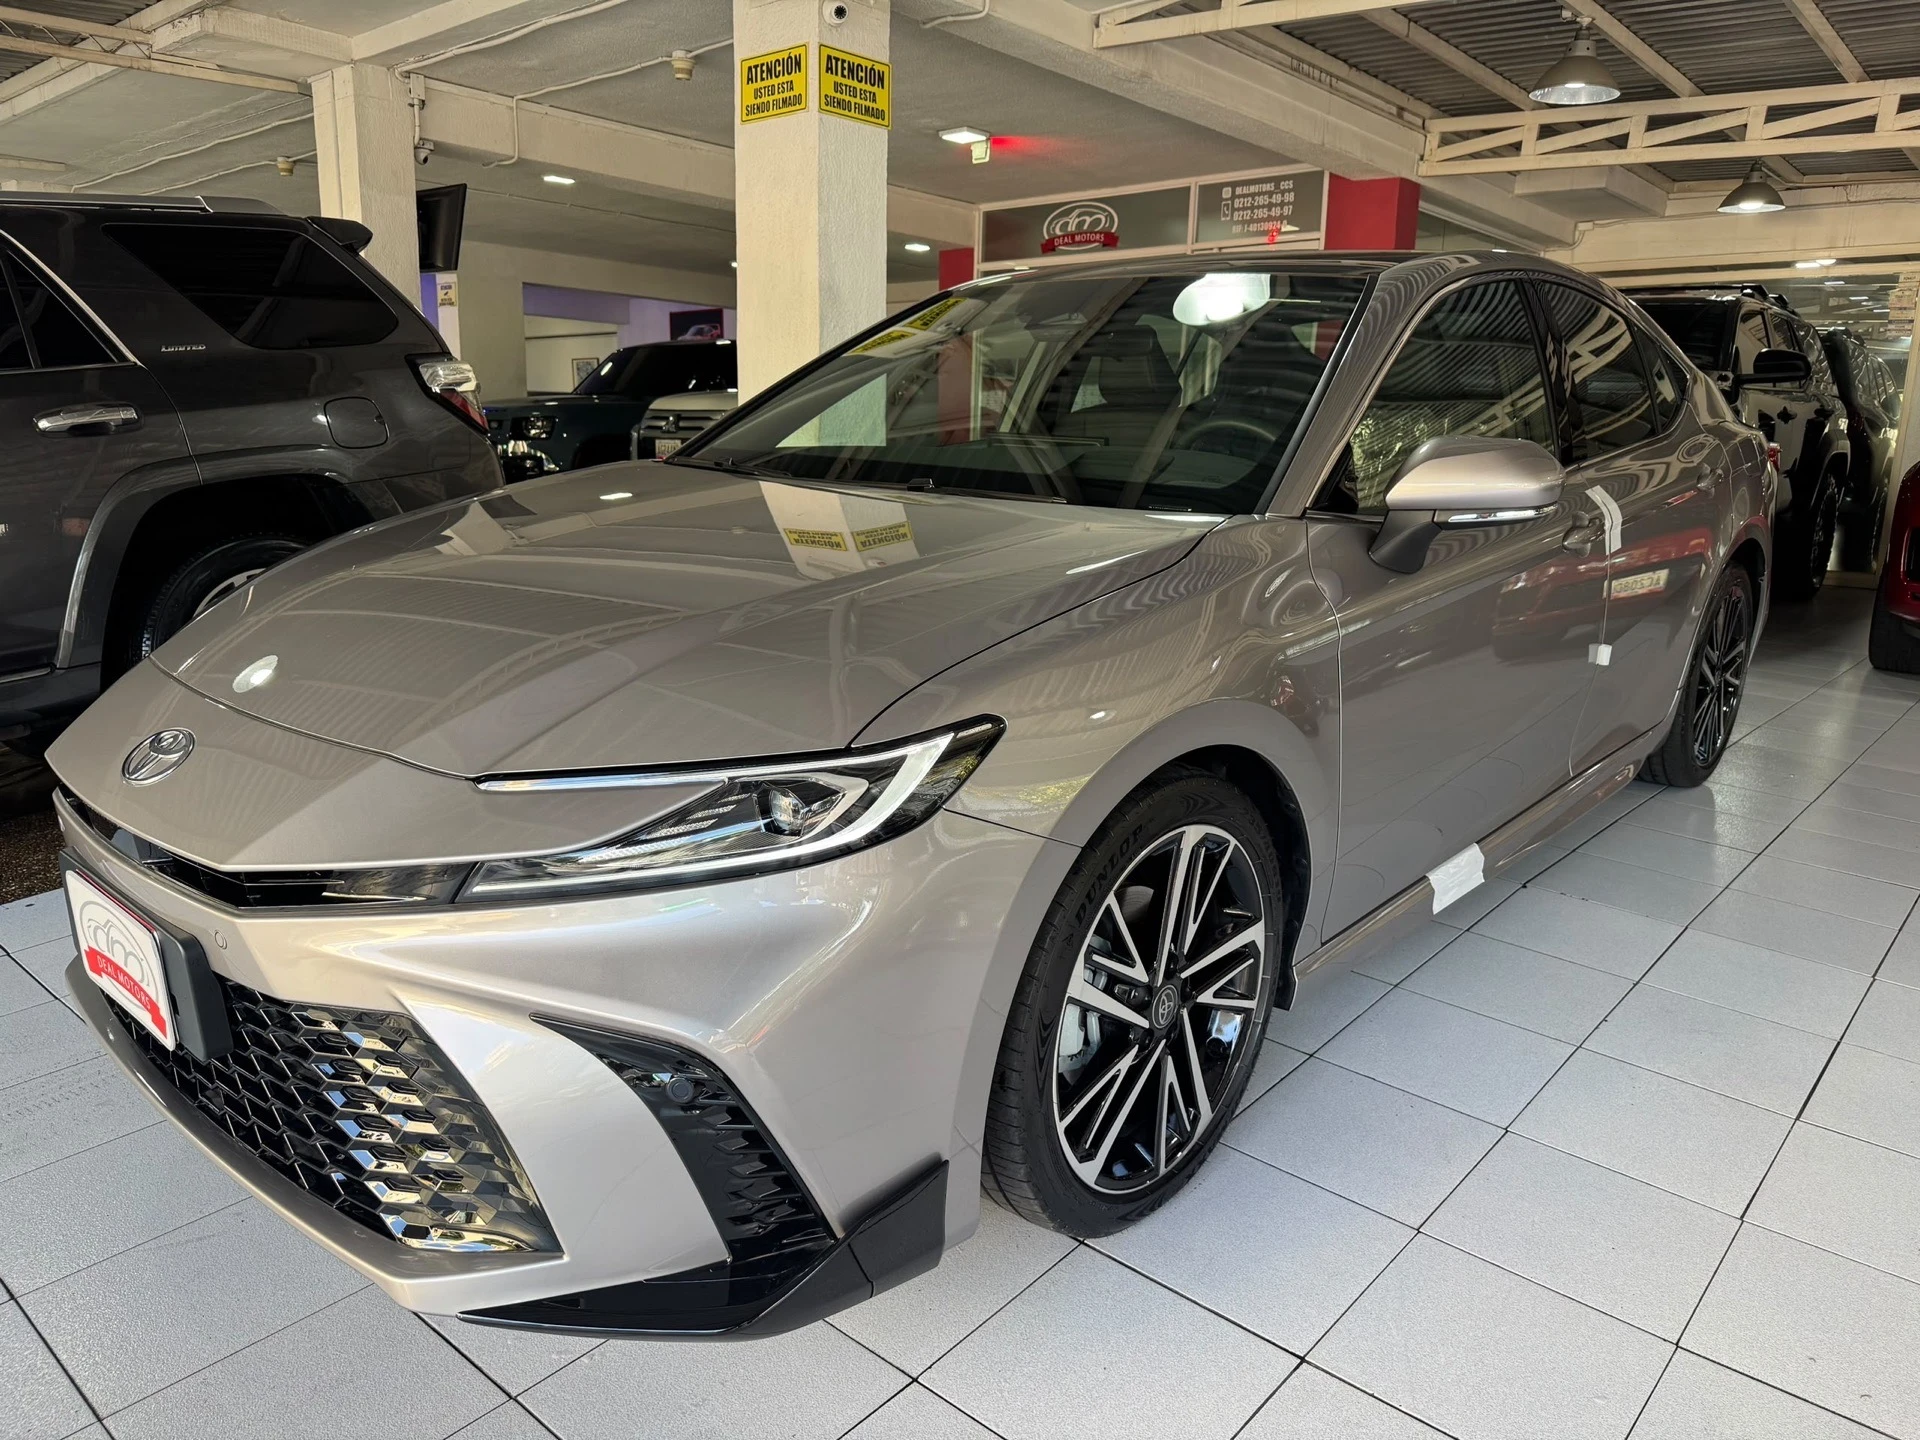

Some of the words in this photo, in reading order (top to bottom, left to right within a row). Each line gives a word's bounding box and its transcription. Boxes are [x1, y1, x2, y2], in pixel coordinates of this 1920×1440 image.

[746, 52, 801, 85] ATENCIÓN
[825, 53, 885, 90] ATENCIÓN
[753, 83, 775, 100] USTED
[777, 80, 794, 93] ESTA
[833, 81, 857, 98] USTED
[860, 88, 877, 104] ESTA
[745, 100, 770, 117] SIENDO
[772, 93, 803, 111] FILMADO
[824, 94, 852, 113] SIENDO
[853, 103, 886, 121] FILMADO
[1054, 236, 1073, 246] DEAL
[1074, 233, 1105, 242] MOTORS
[1075, 824, 1143, 925] DUNLOP
[96, 955, 117, 979] DEAL
[117, 969, 151, 1010] MOTORS
